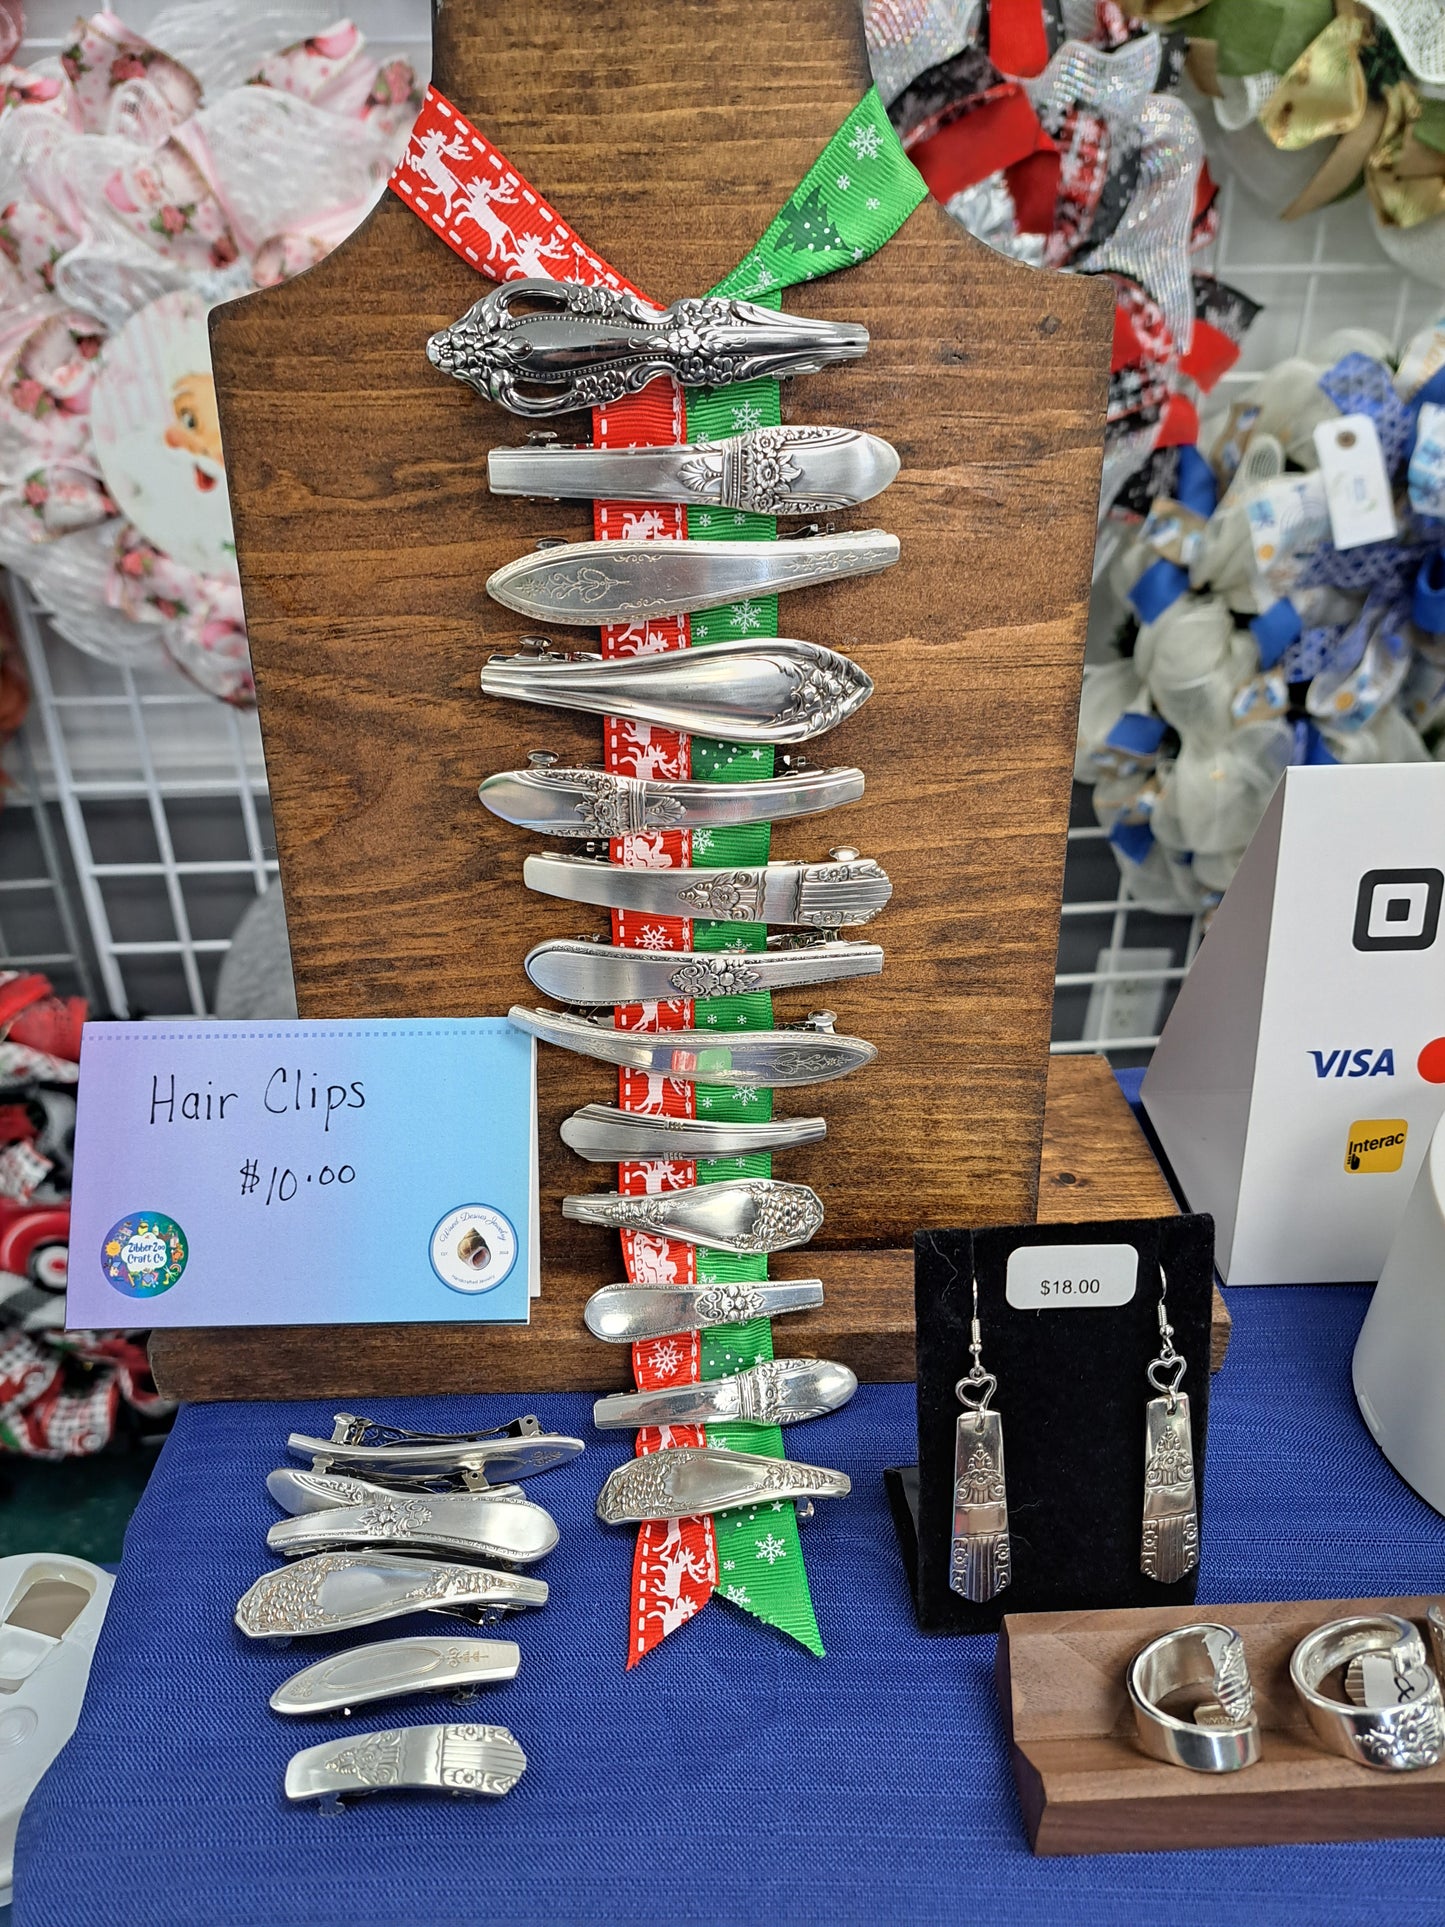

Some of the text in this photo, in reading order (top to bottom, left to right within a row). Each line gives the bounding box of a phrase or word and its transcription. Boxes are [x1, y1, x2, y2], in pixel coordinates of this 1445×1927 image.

[1306, 1048, 1395, 1078] VISA
[150, 1067, 366, 1132] Hair Clips
[1348, 1132, 1405, 1155] Interac
[239, 1158, 356, 1206] $10.00
[127, 1253, 152, 1264] Craft
[1040, 1278, 1101, 1296] $18.00
